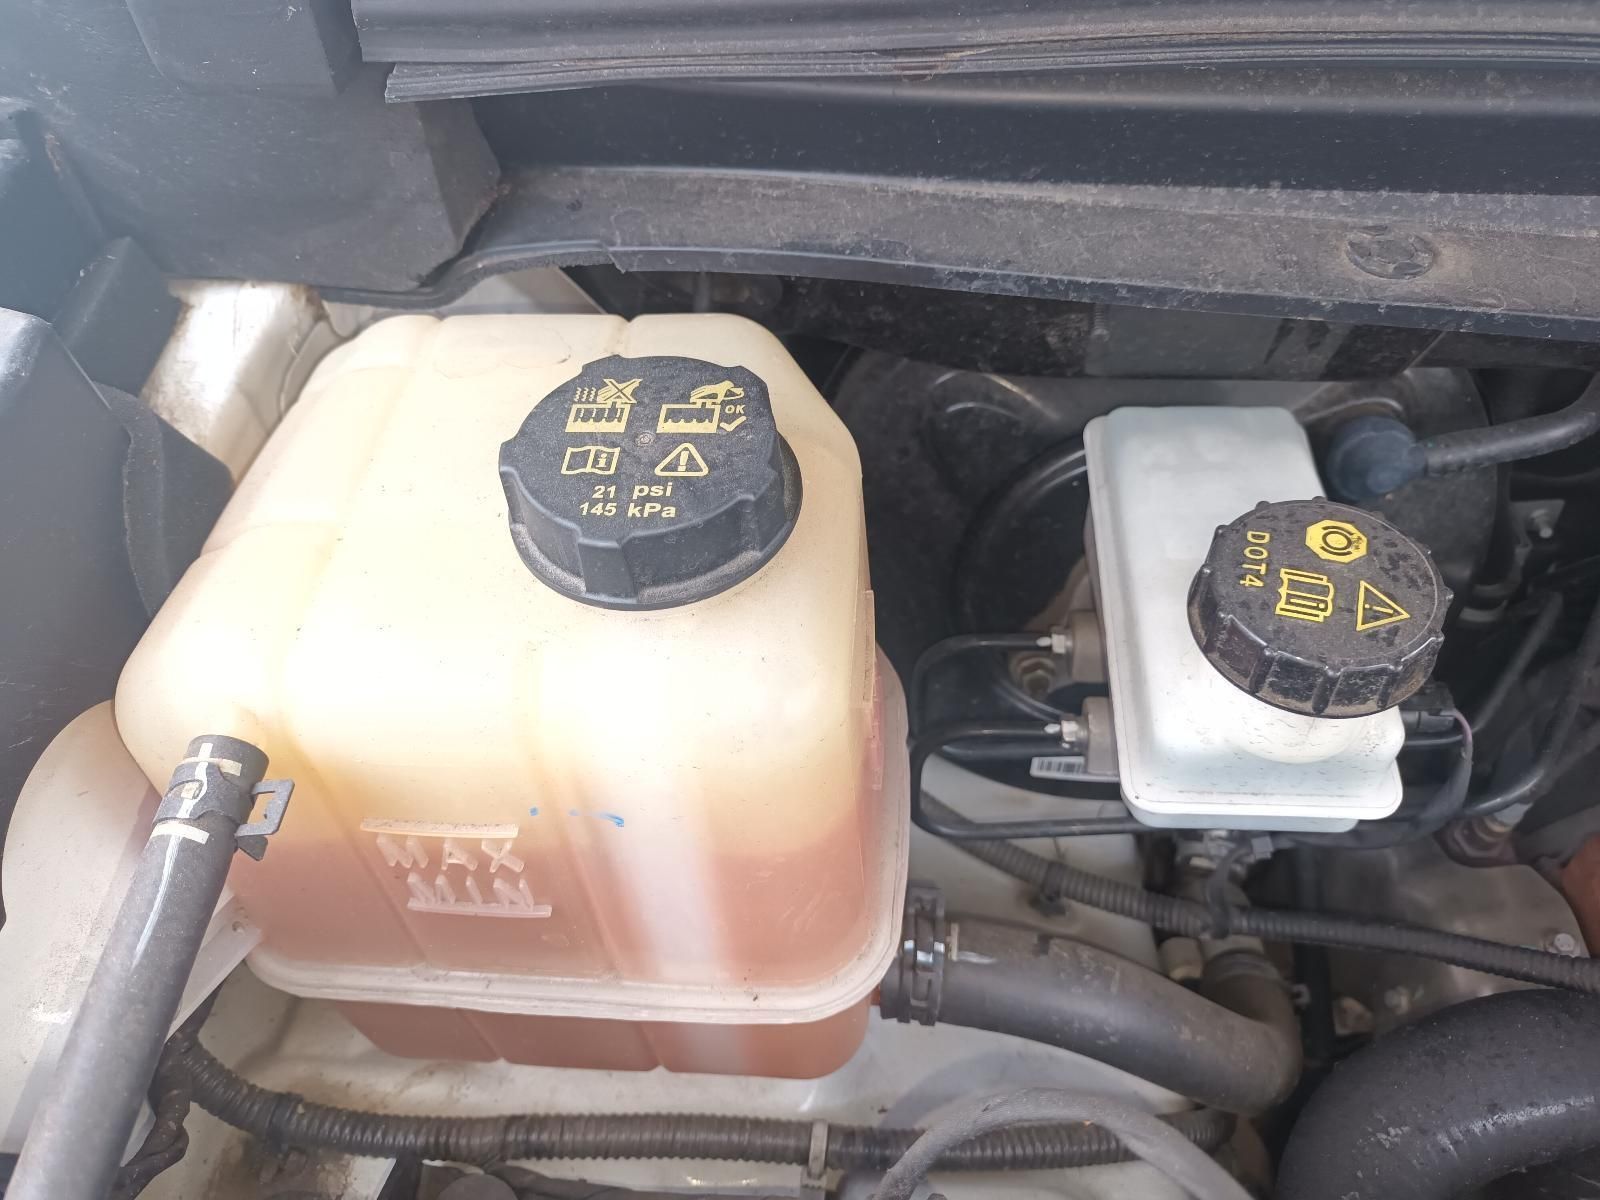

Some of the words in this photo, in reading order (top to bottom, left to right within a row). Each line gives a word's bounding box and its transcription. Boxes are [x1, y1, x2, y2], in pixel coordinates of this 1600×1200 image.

[724, 404, 746, 415] OK
[592, 485, 616, 499] 21
[632, 482, 673, 500] psi
[580, 502, 617, 516] 145
[627, 502, 676, 518] kPa
[1239, 530, 1271, 588] DOT4
[376, 832, 525, 873] MAX
[407, 871, 535, 910] MIN
